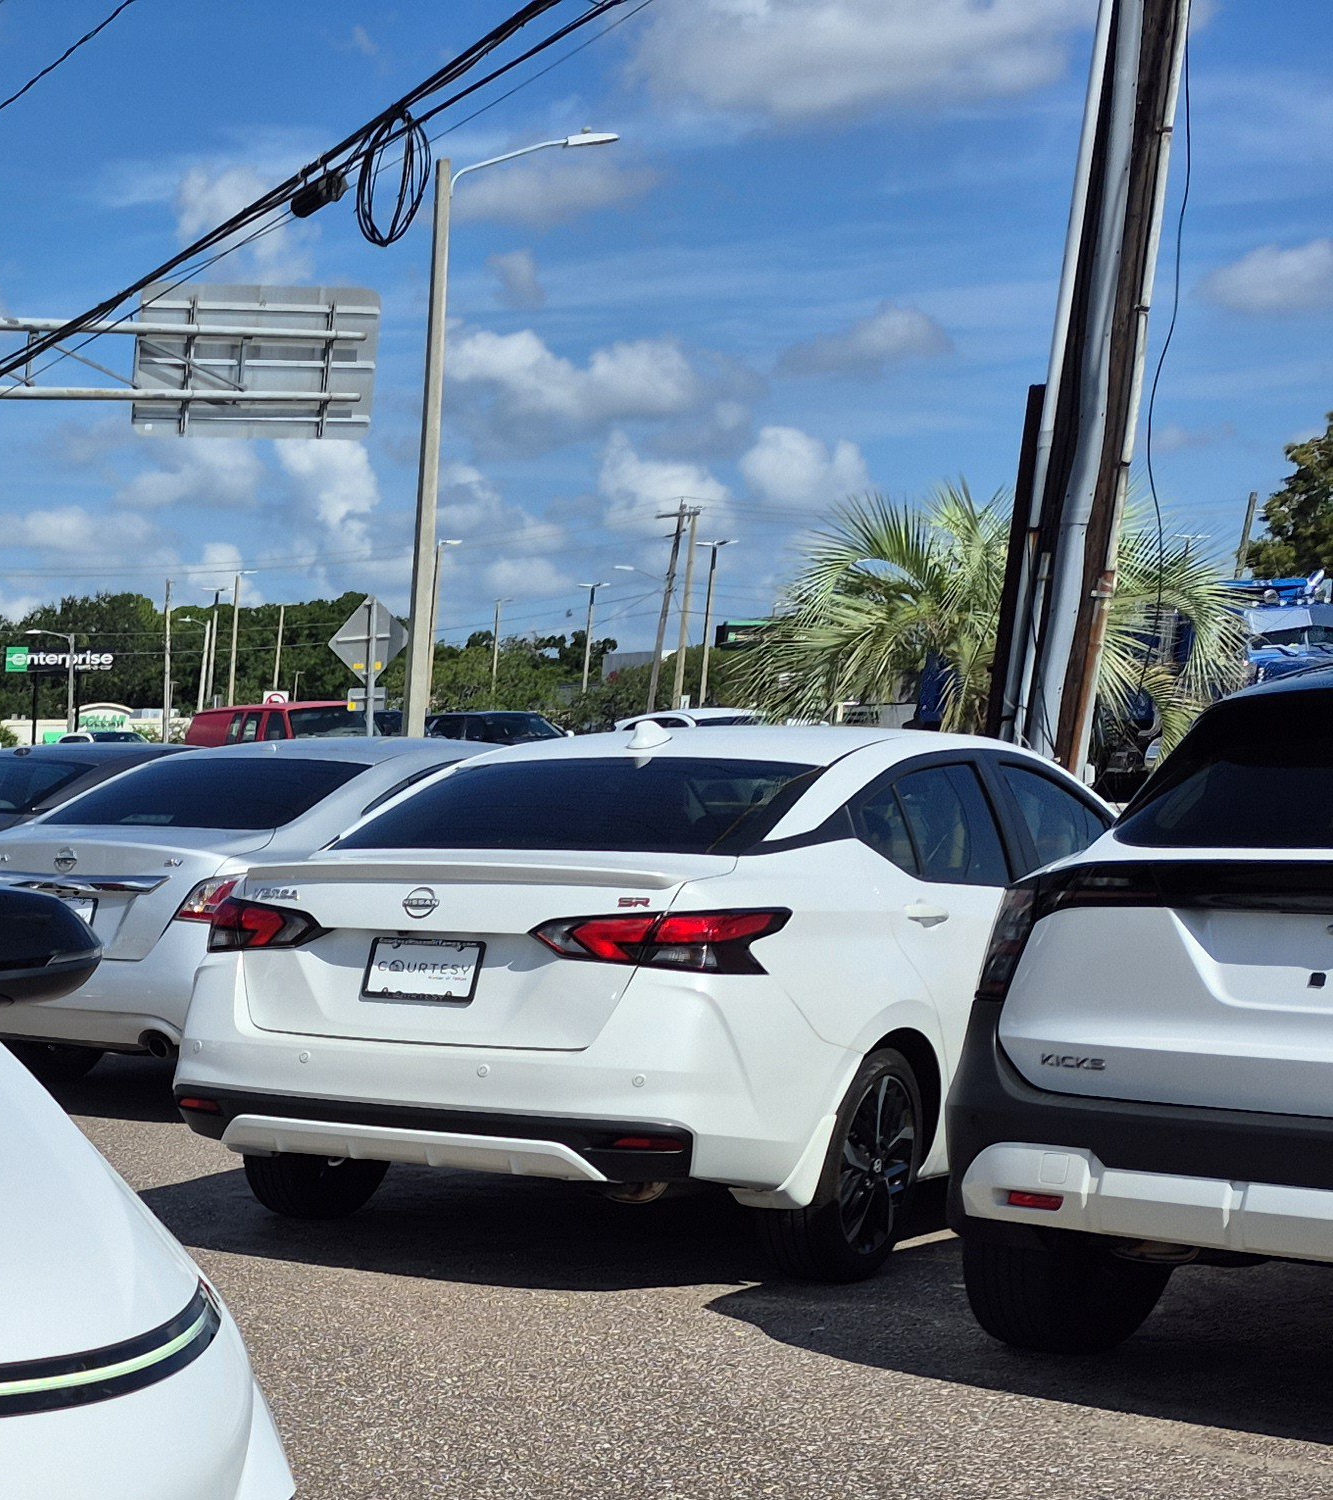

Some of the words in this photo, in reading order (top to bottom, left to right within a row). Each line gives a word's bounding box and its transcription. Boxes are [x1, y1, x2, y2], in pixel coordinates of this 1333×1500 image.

[5, 650, 114, 669] enterprise
[617, 897, 650, 908] SR
[377, 960, 473, 976] COURTESY
[1040, 1053, 1106, 1071] KICKS
